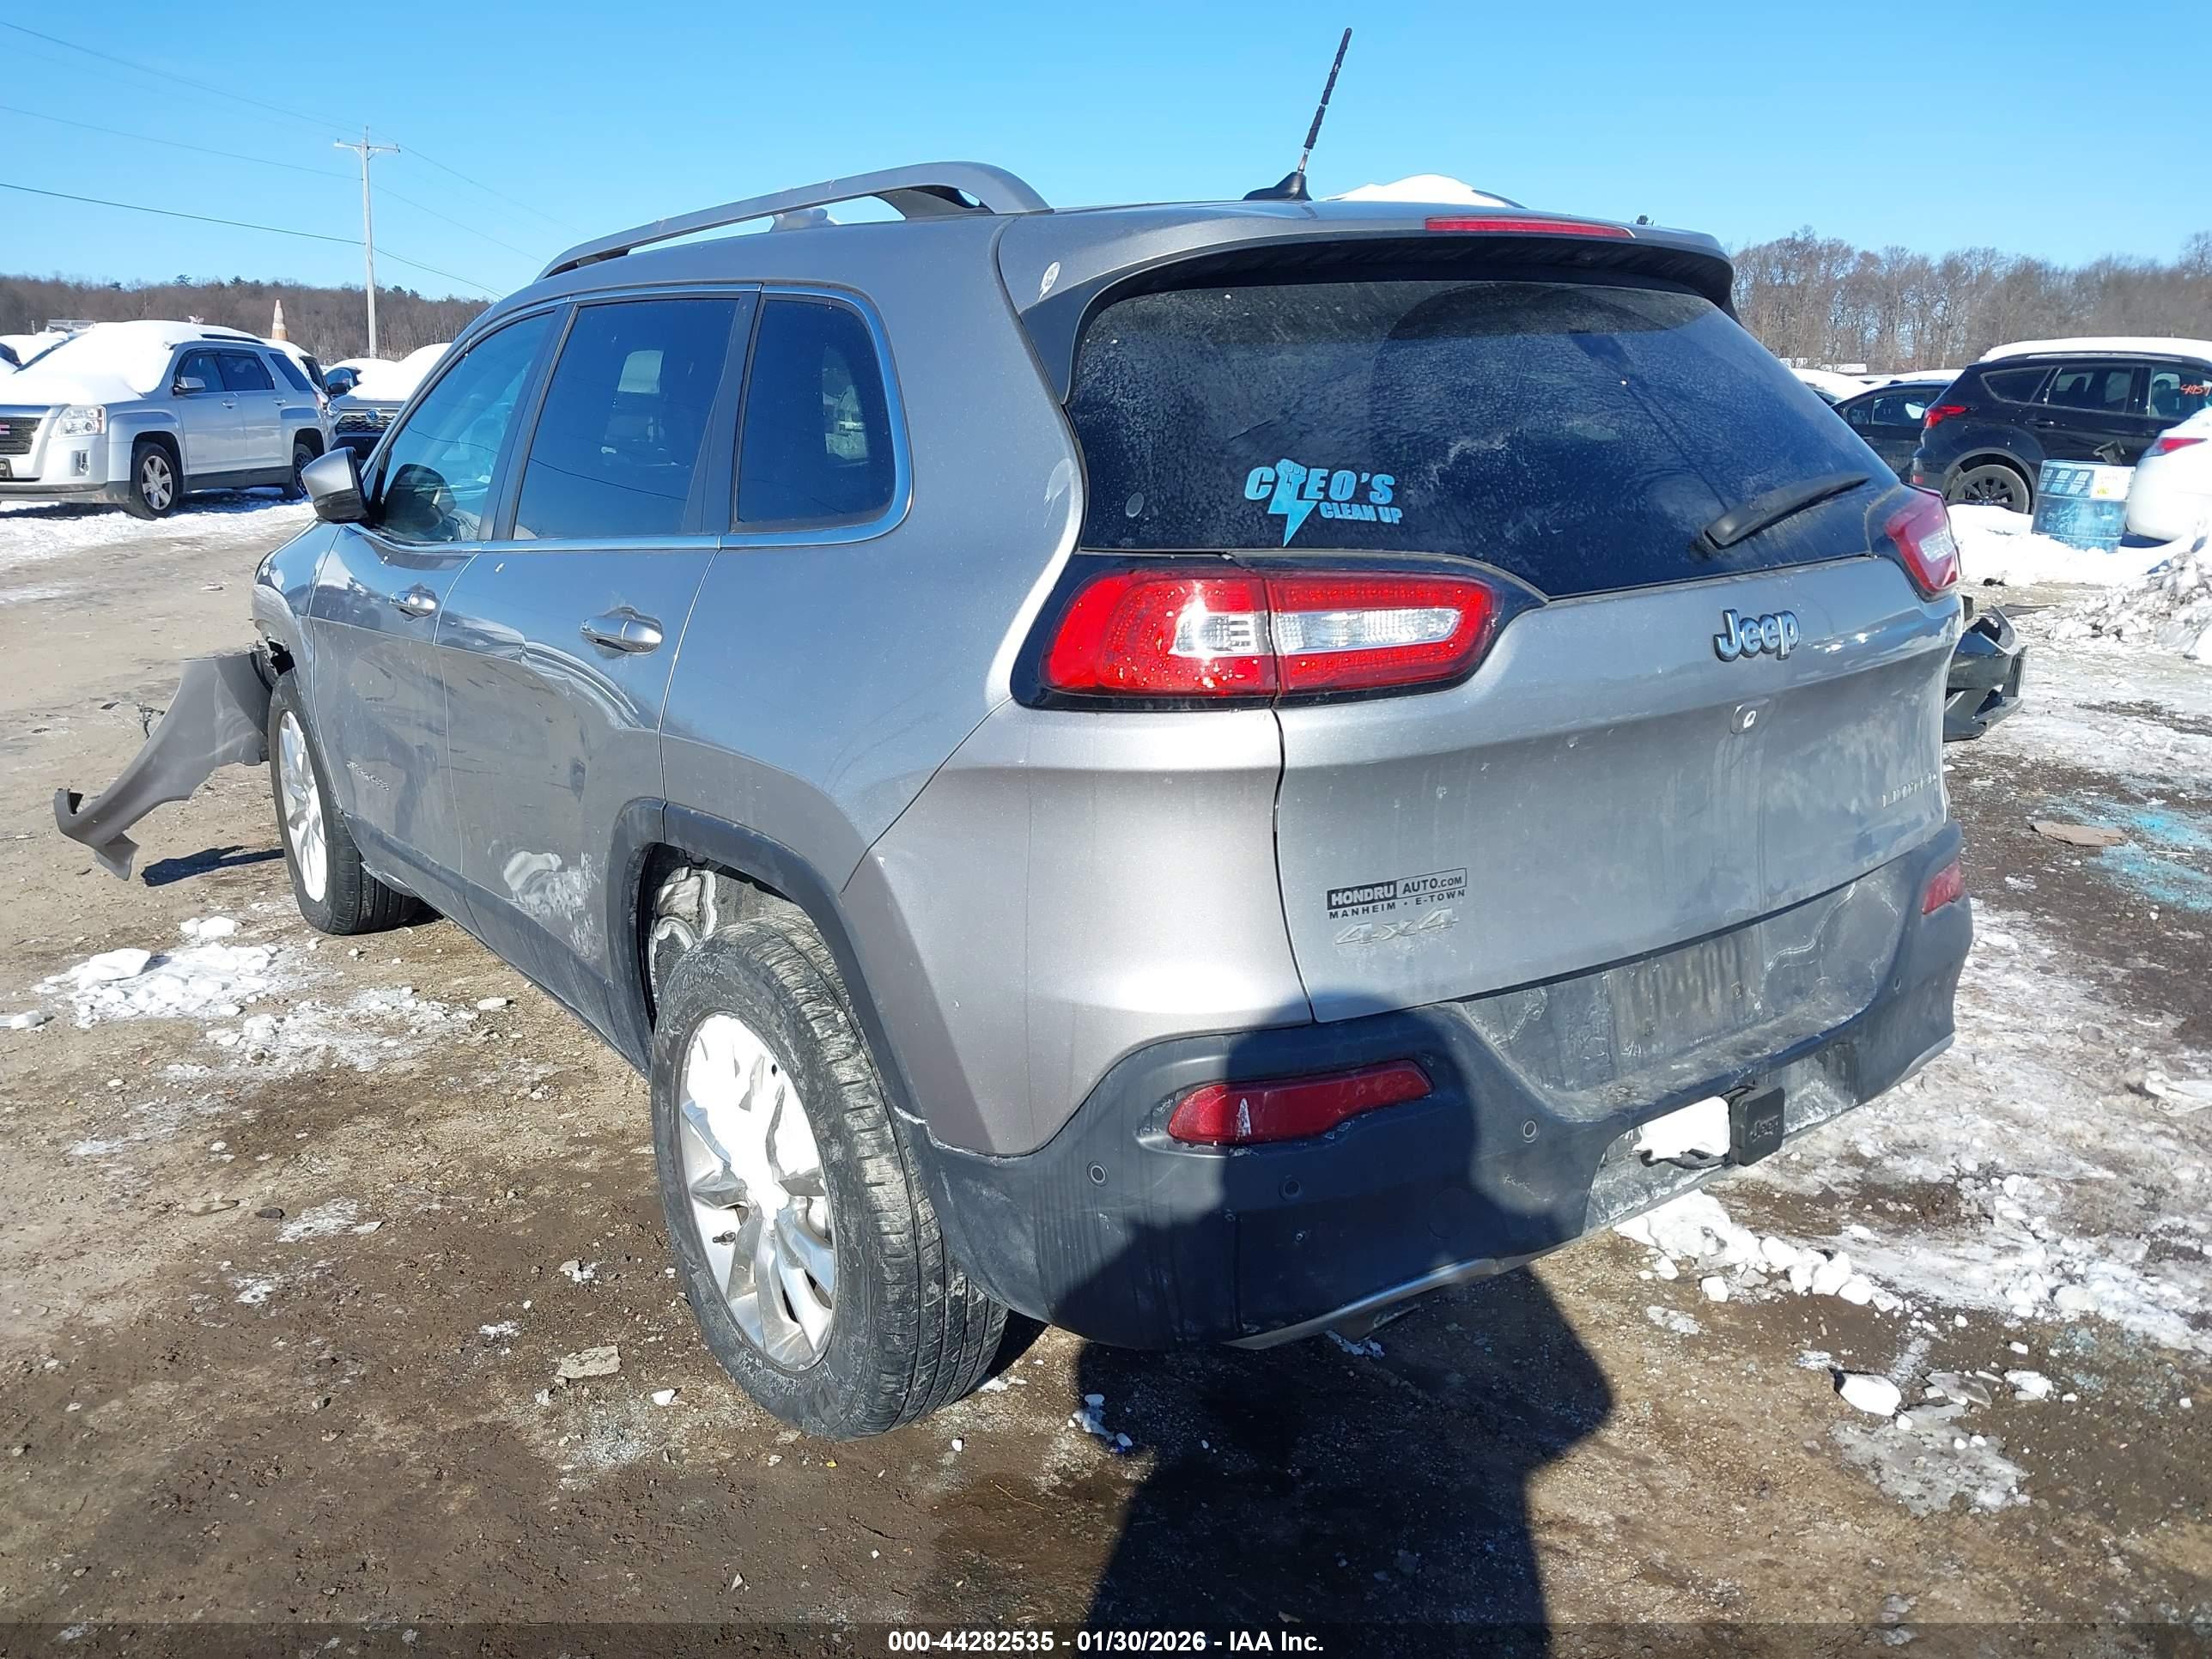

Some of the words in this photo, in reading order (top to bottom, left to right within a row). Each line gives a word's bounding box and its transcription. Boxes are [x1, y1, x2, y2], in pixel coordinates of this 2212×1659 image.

[1319, 501, 1376, 522] CLEAN
[1375, 507, 1403, 524] UP
[1713, 609, 1800, 662] Jeep
[1329, 902, 1396, 920] MANHEIM
[1415, 889, 1466, 906] E-TOWN
[1331, 884, 1395, 907] HONDRU
[1750, 1115, 1780, 1142] Jeep
